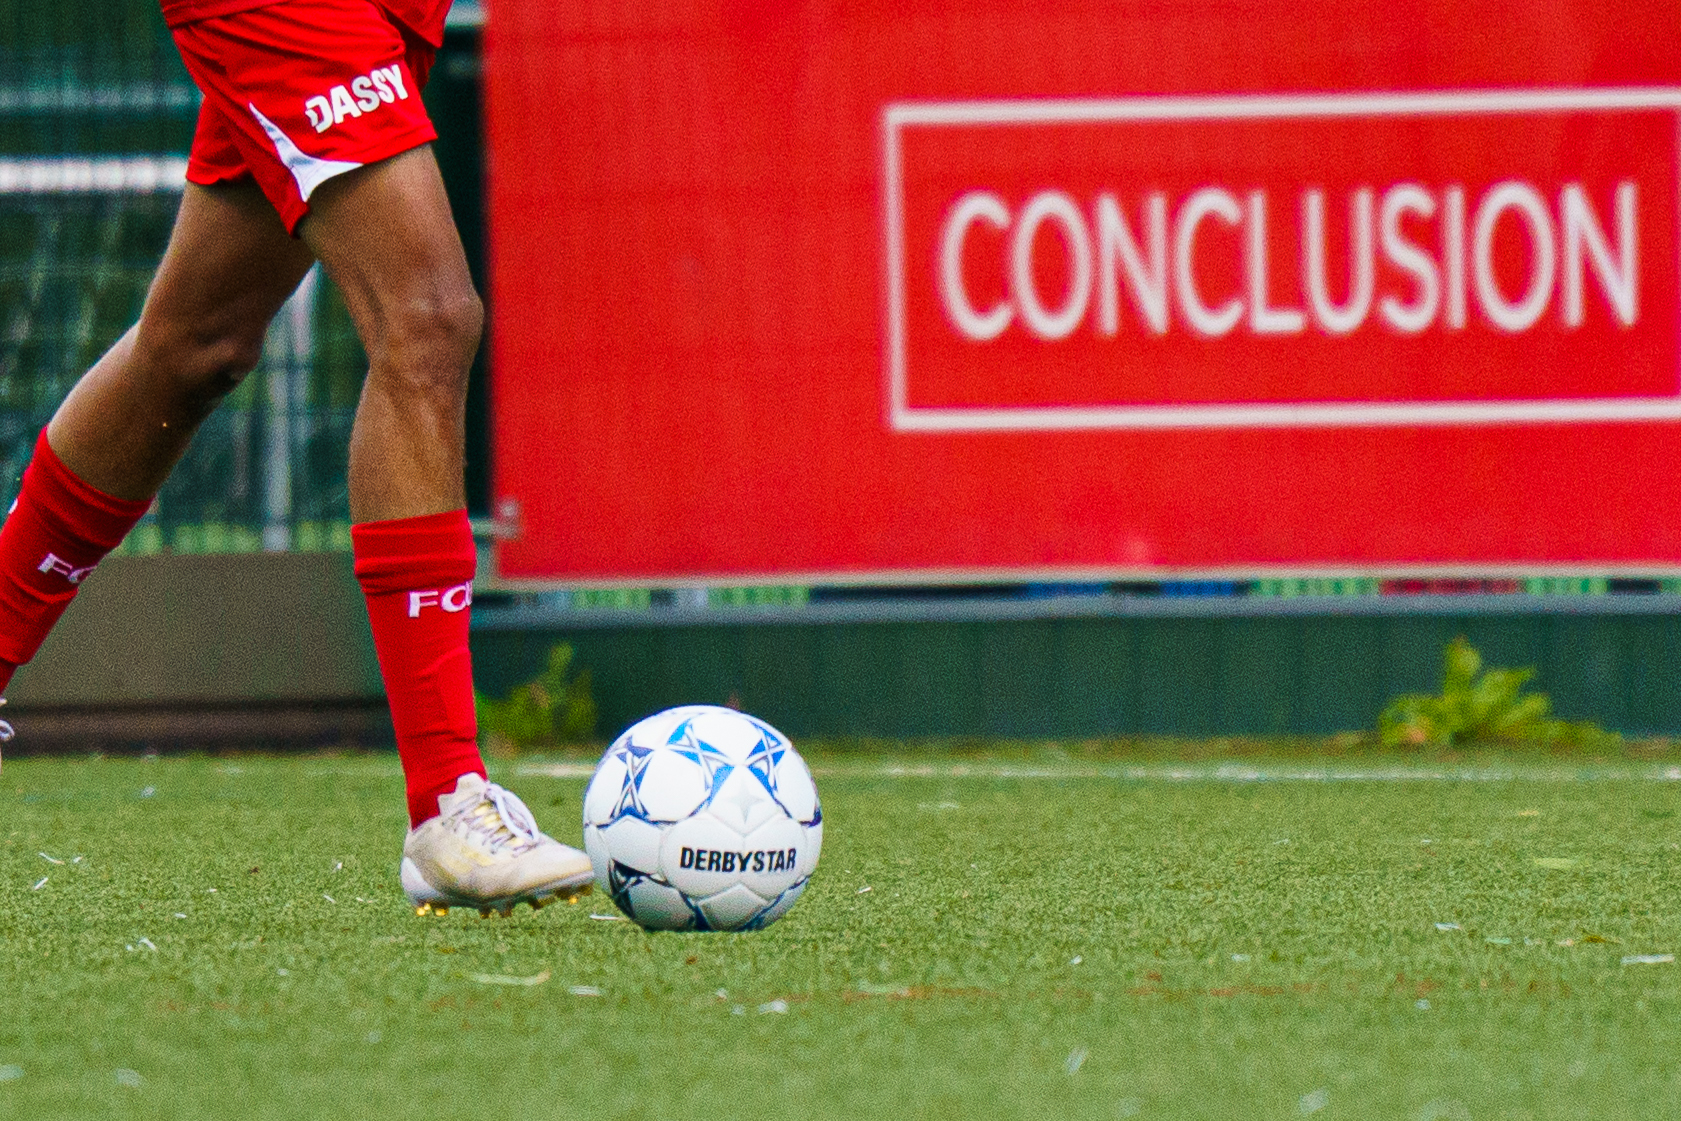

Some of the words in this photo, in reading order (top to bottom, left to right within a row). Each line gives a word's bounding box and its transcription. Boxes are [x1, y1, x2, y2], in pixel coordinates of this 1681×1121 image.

[305, 64, 408, 133] DASSY
[937, 180, 1639, 341] CONCLUSION
[680, 847, 797, 873] DERBYSTAR
